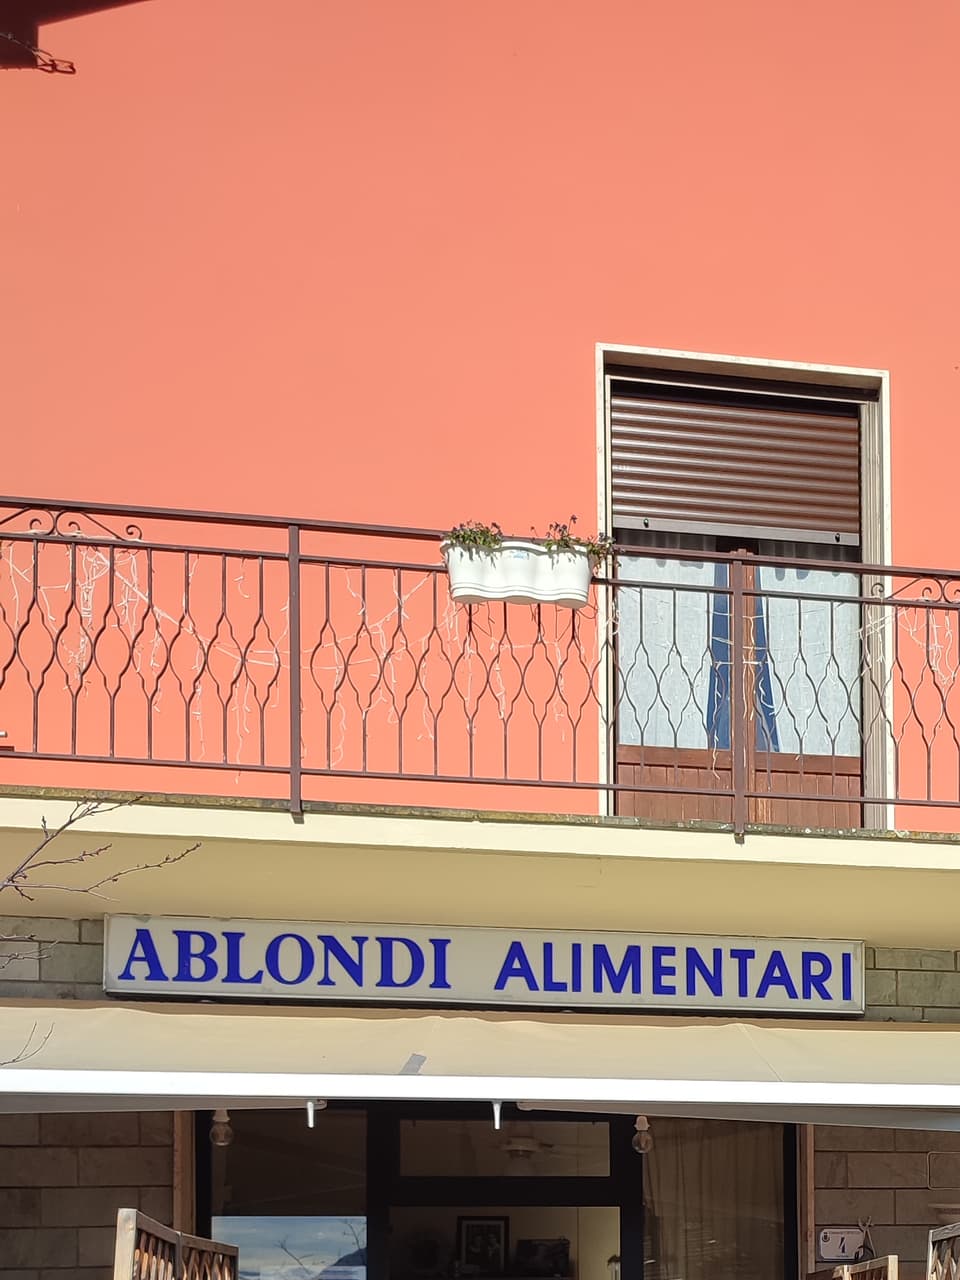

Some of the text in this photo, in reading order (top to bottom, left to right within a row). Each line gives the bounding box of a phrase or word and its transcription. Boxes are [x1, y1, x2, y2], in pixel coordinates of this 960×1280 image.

[118, 928, 853, 1001] ABLONDI ALIMENTARI
[839, 1236, 846, 1254] 4
